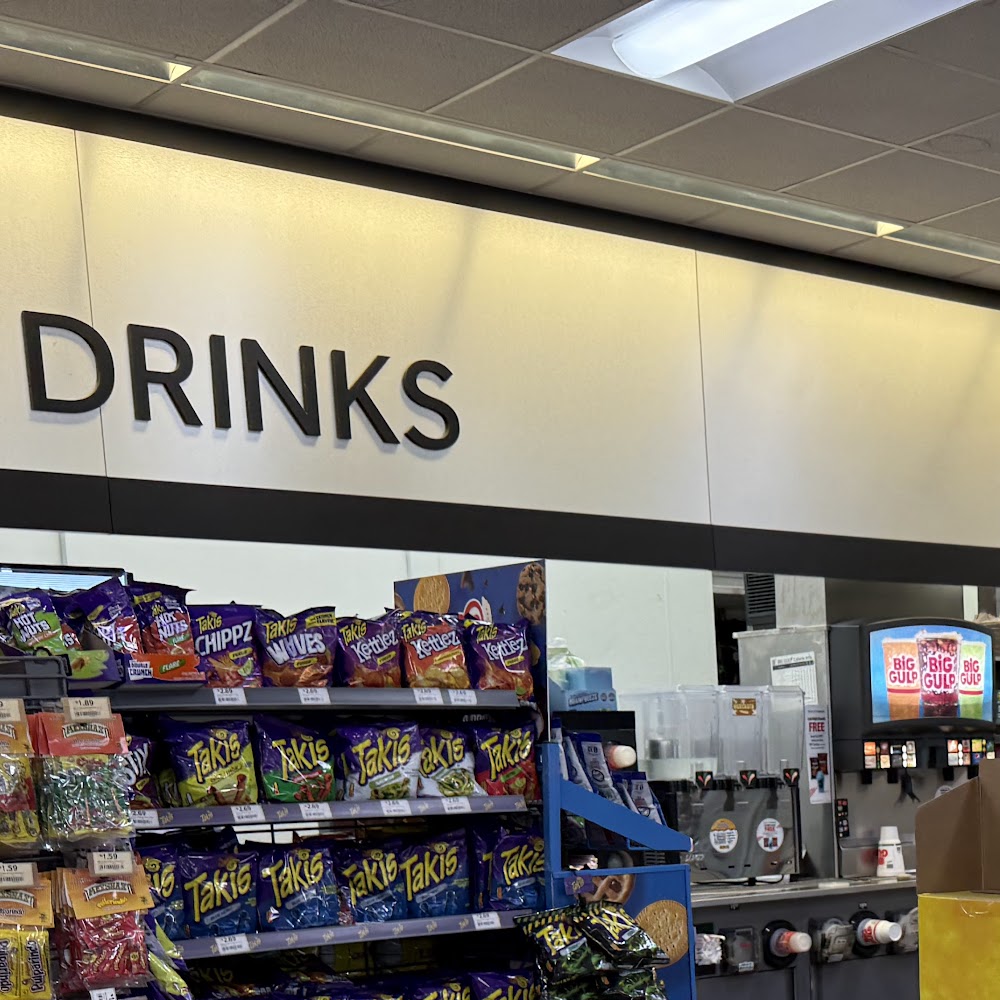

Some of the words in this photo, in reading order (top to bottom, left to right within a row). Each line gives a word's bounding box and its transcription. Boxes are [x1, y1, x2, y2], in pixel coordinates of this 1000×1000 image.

[21, 310, 461, 451] DRINKS
[13, 611, 37, 630] HOT
[20, 619, 51, 642] NUTS
[155, 610, 177, 627] HOT
[157, 618, 189, 641] NUTS
[196, 611, 223, 635] Takis
[262, 617, 298, 644] Takis
[401, 619, 428, 643] Takis
[194, 620, 253, 657] CHIPPZ
[339, 619, 367, 646] Takis
[410, 630, 461, 660] Kettlez
[476, 623, 498, 644] Takis
[350, 630, 399, 663] Kettlez
[482, 637, 528, 662] Kettlez
[889, 670, 918, 684] GULP
[923, 673, 956, 690] GULP
[960, 672, 982, 686] GULP
[808, 722, 825, 733] FREE
[187, 729, 241, 784] Takis
[271, 732, 330, 781] Takis
[352, 727, 411, 786] Takis
[480, 728, 532, 782] Takis
[99, 852, 118, 860] $1.59
[262, 849, 325, 908] Takis
[342, 848, 398, 906] Takis
[399, 841, 459, 902] Takis
[184, 859, 252, 923] Takis
[25, 939, 47, 994] Pulparindo
